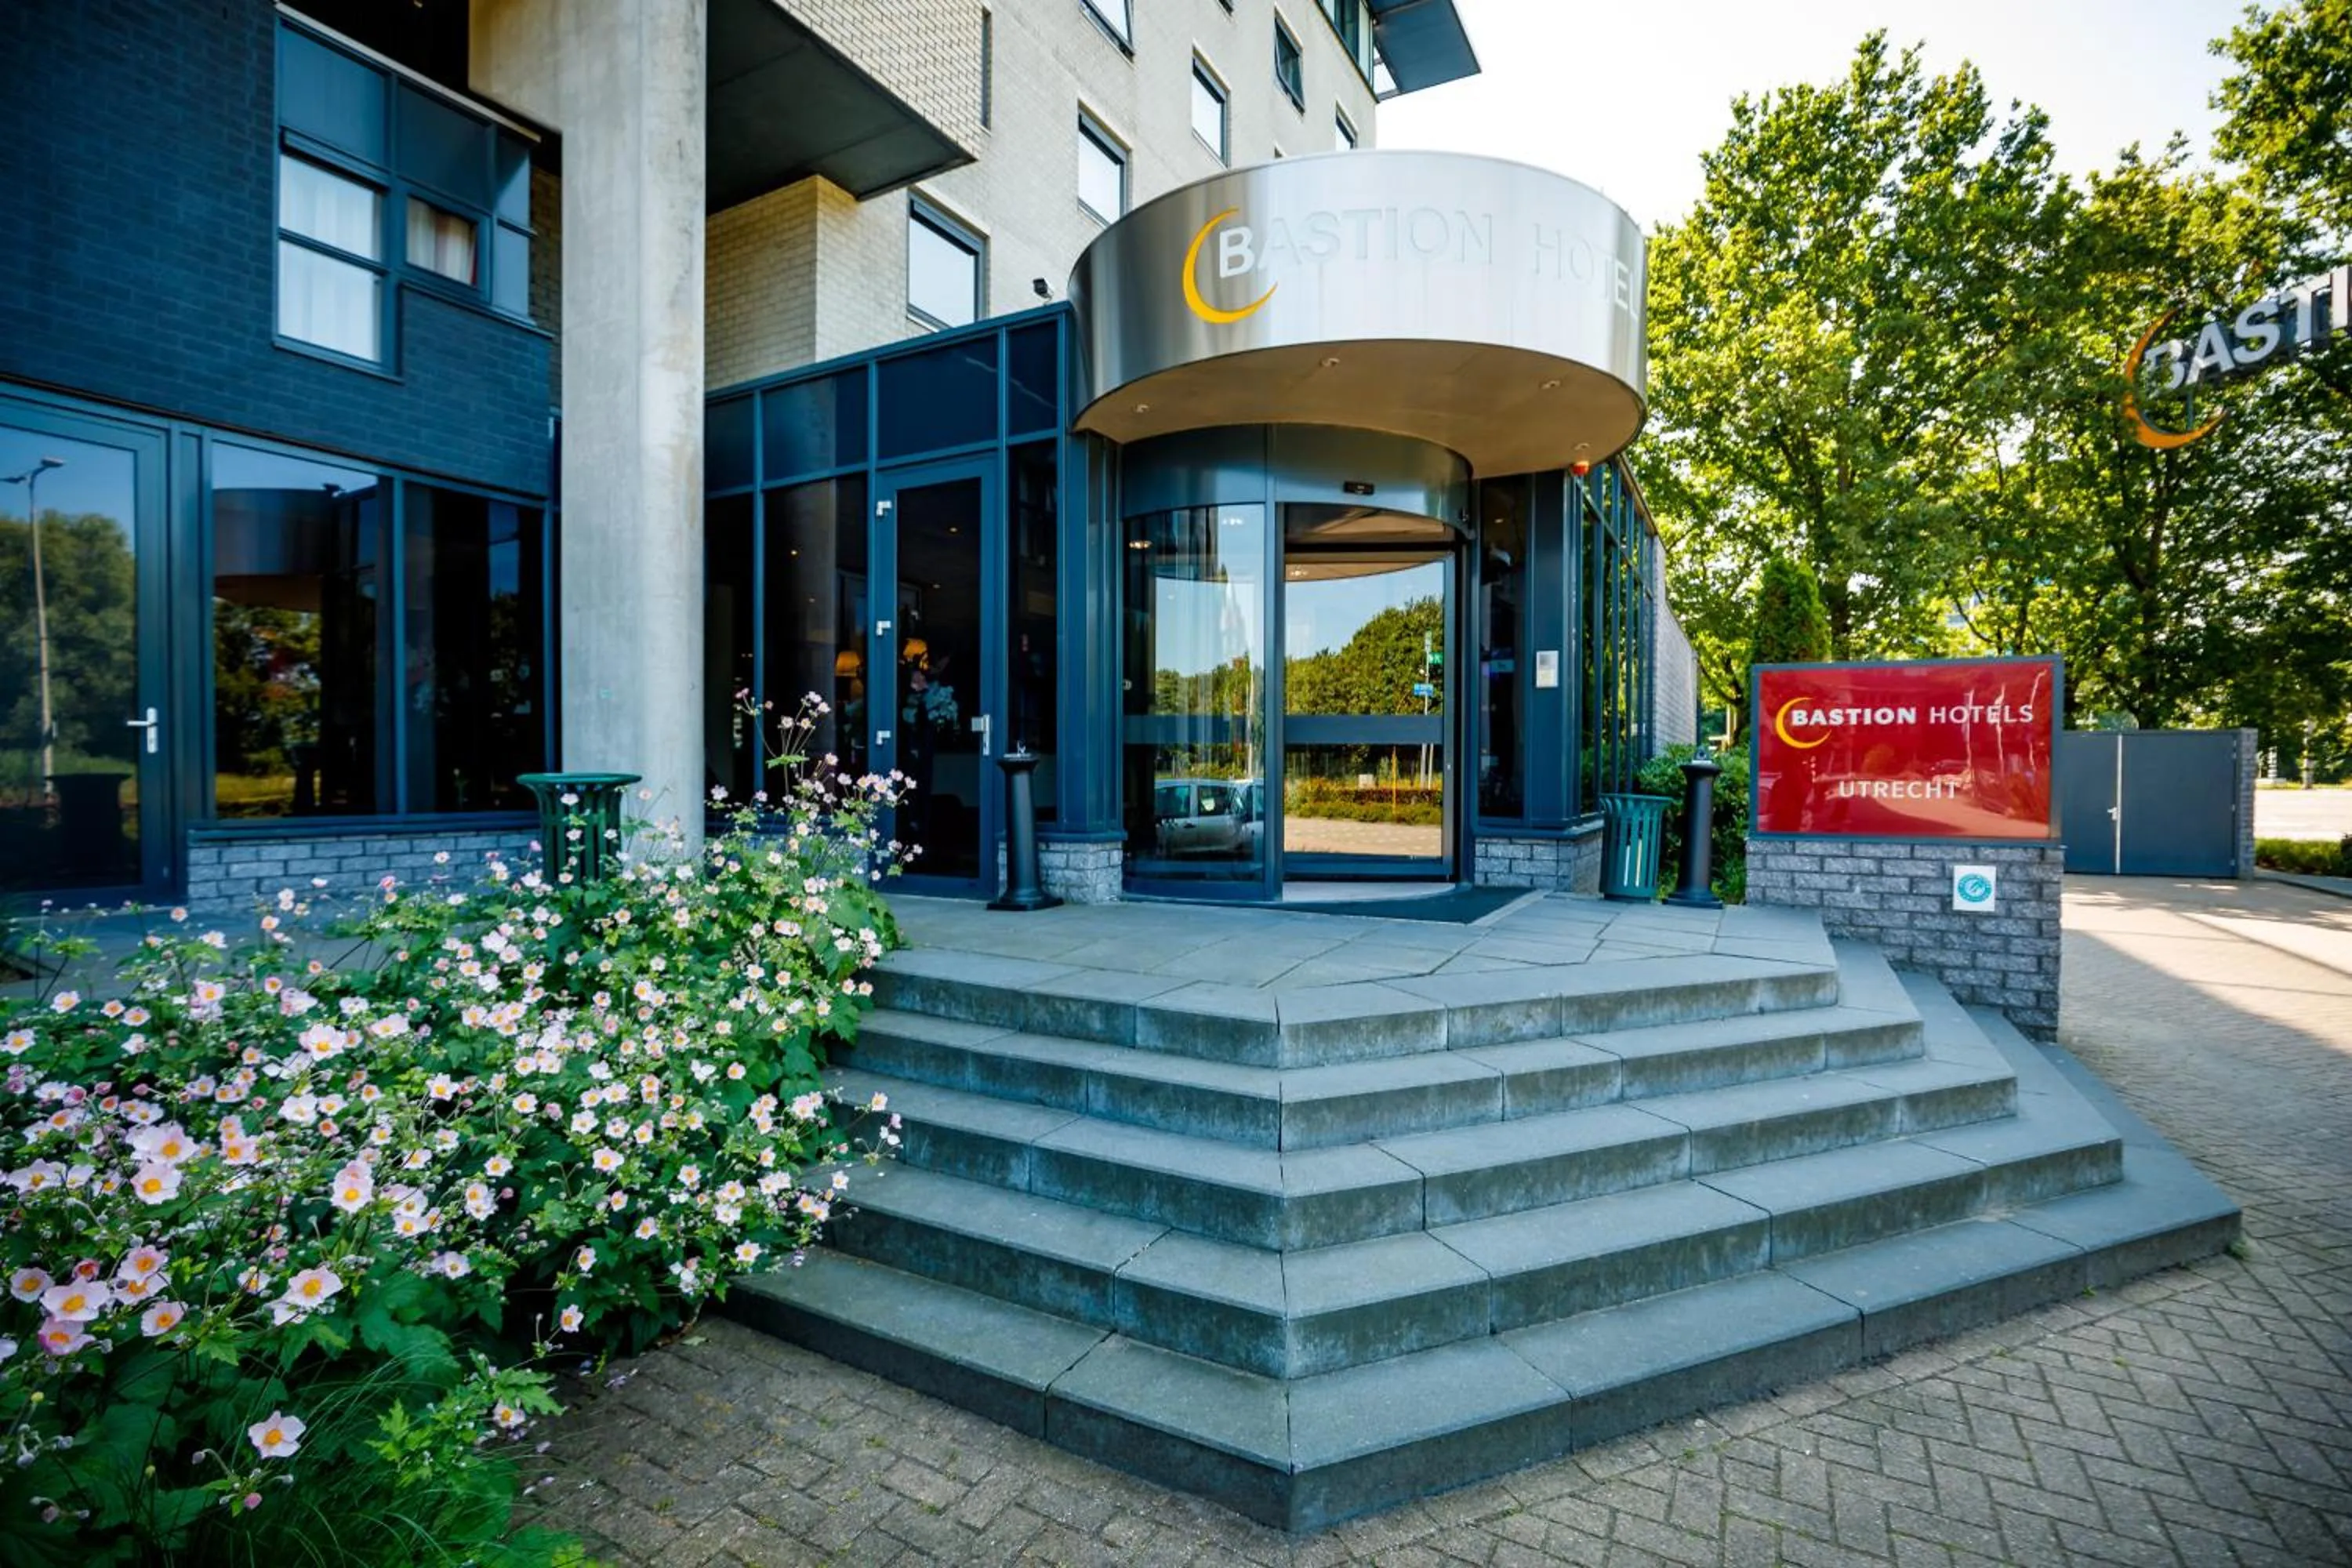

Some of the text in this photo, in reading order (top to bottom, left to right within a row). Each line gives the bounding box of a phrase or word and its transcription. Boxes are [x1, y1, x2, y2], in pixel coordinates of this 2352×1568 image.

[1218, 207, 1494, 280] BASTION
[1791, 705, 2034, 727] BASTION HOTELS
[1838, 780, 1958, 800] UTRECHT
